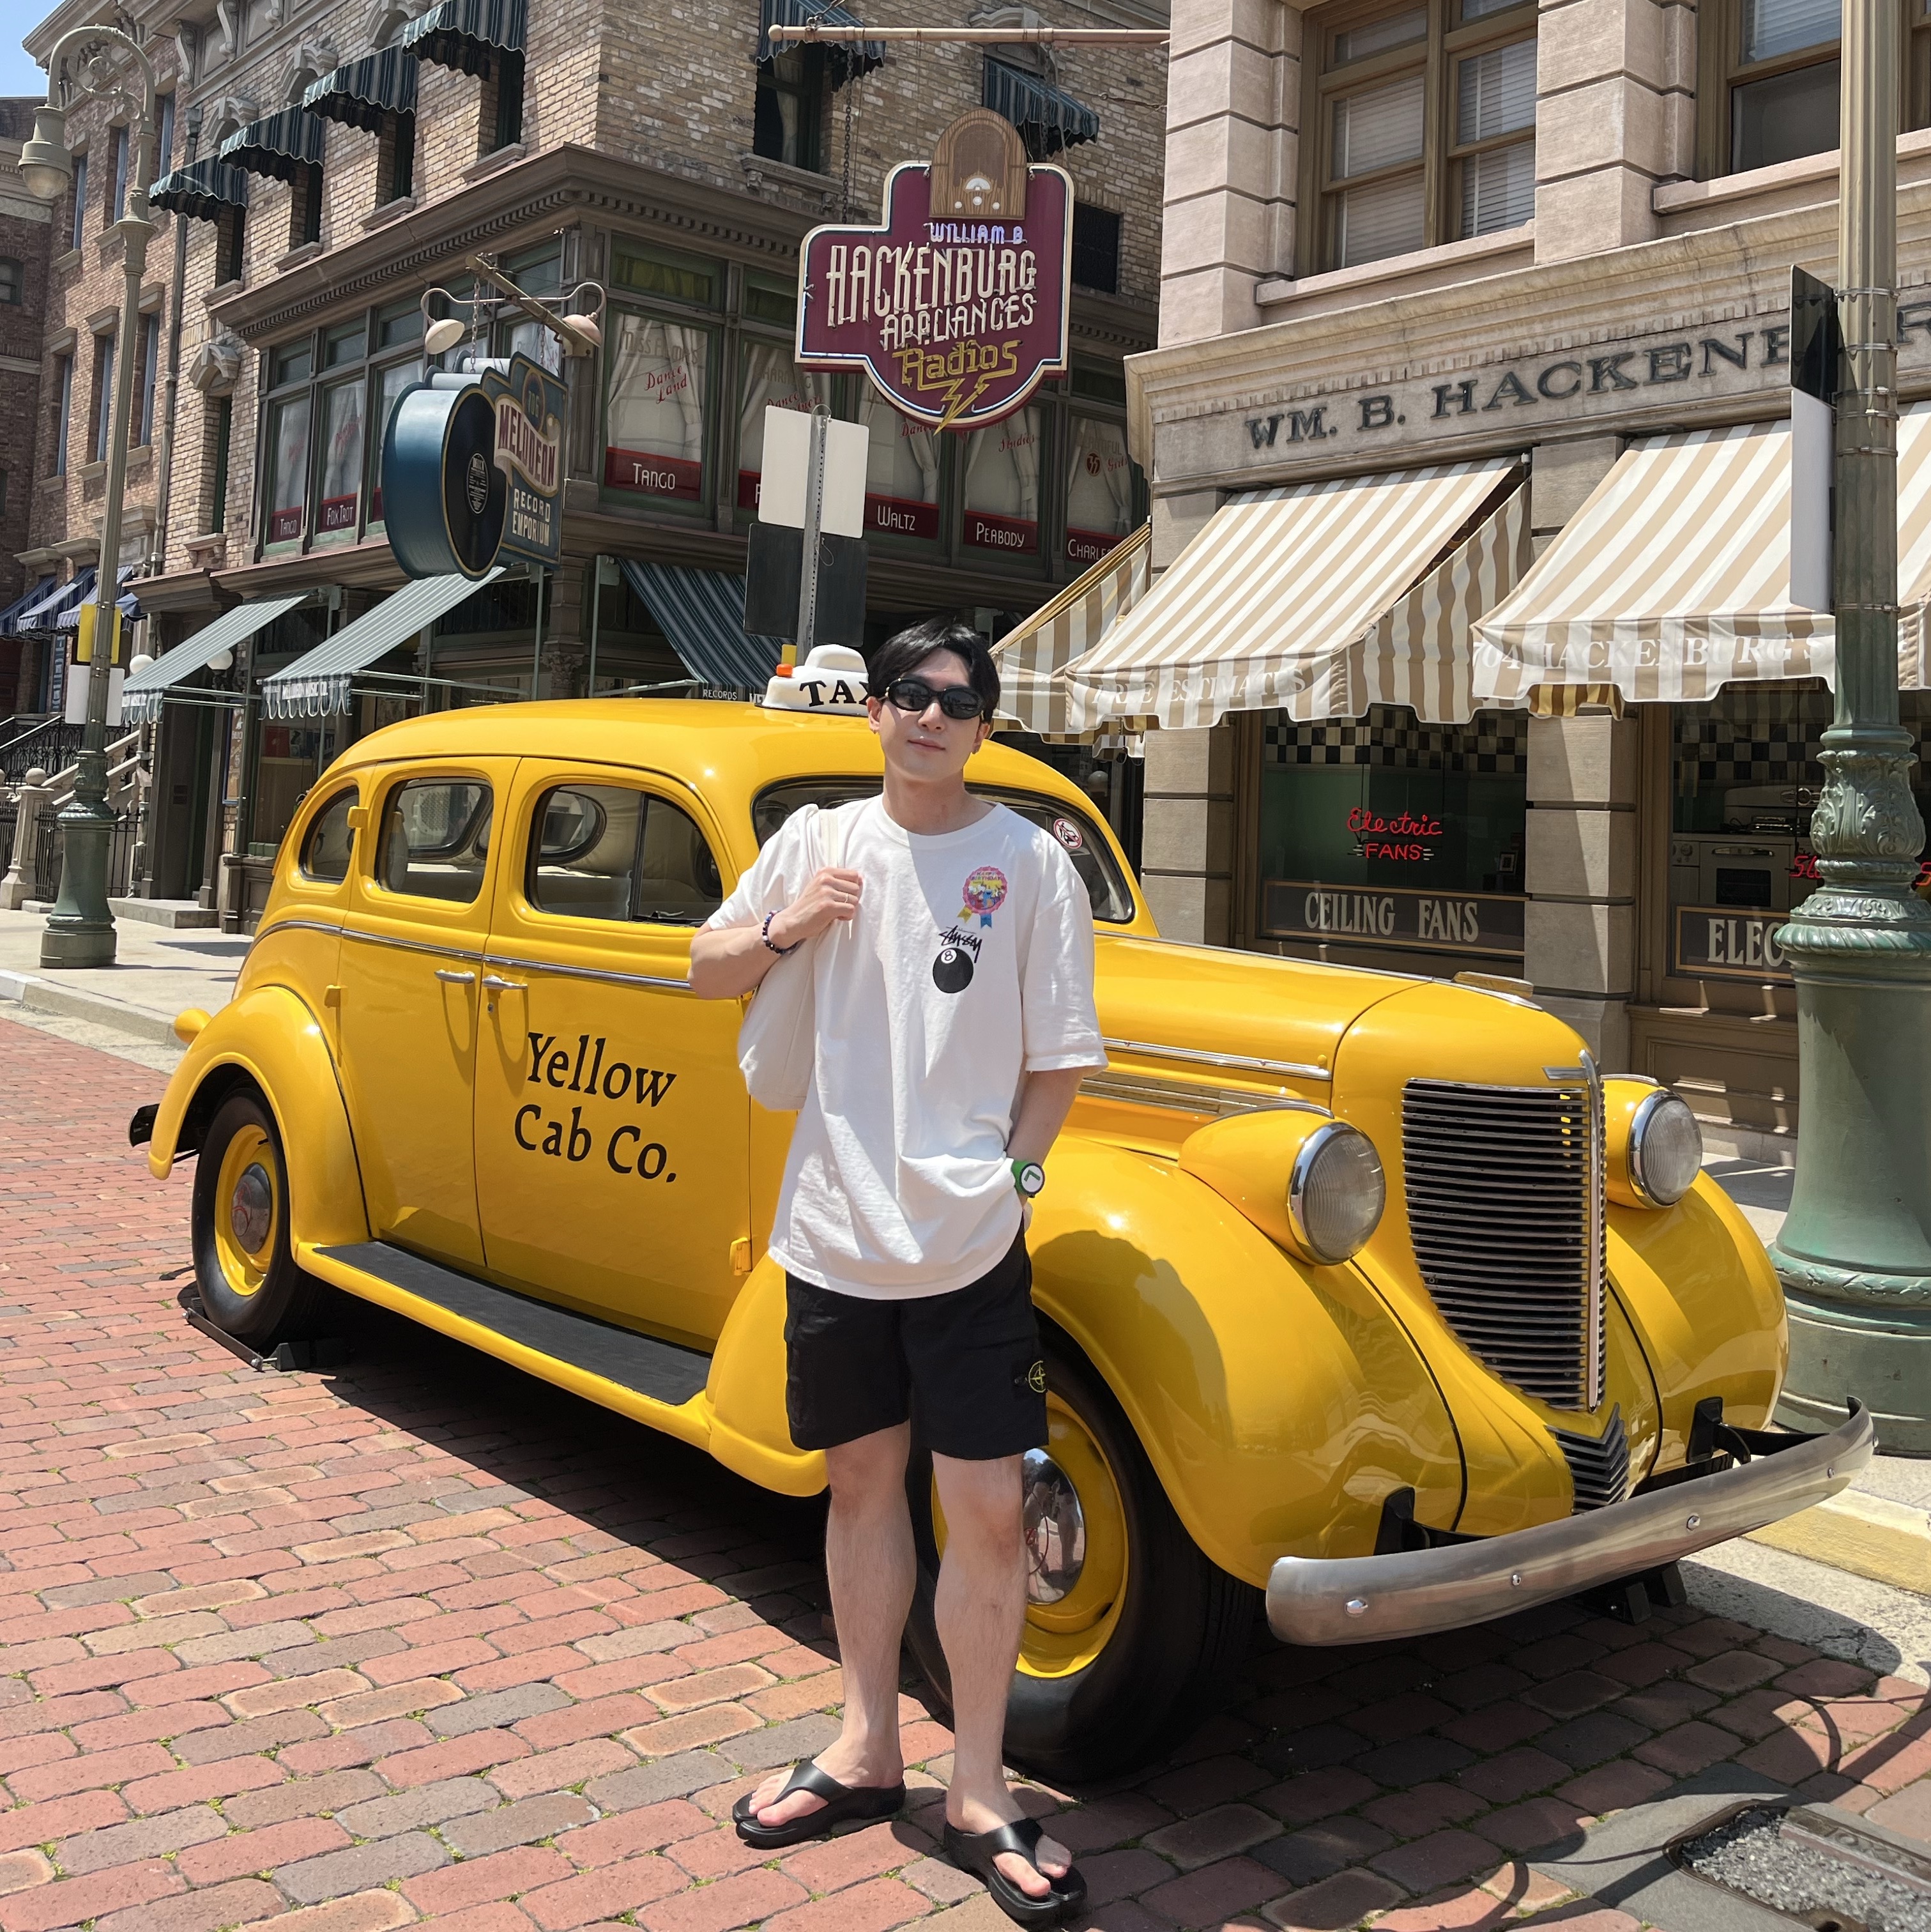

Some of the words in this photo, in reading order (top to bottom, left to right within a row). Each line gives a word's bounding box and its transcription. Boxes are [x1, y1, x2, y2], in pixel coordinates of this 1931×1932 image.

[929, 223, 1005, 244] WILLIAM
[826, 243, 1037, 329] HACKENBURG
[880, 293, 1037, 351] APPLIANCES
[892, 340, 1023, 389] Radios
[1244, 406, 1337, 449] WM.
[1357, 394, 1406, 433] B.
[498, 404, 556, 487] MELODEON
[633, 463, 676, 490] TANGO
[514, 487, 551, 523] RECORD
[878, 505, 916, 531] WALTZ
[512, 511, 549, 547] EMPORIUM
[976, 522, 1025, 548] PEABODY
[1472, 641, 1522, 670] 704
[1541, 632, 1794, 670] HACKENBURG
[703, 689, 738, 701] RECORDS
[1092, 682, 1156, 705] FREE
[1166, 668, 1306, 702] ESTIMATES
[1347, 807, 1443, 836] Electric
[1364, 843, 1424, 860] FANS
[1304, 892, 1396, 936] CEILING
[1417, 898, 1479, 942] FANS
[1707, 918, 1786, 967] ELEC
[527, 1032, 678, 1108] Yellow
[514, 1104, 592, 1162] Cab
[607, 1125, 677, 1183] Co.
